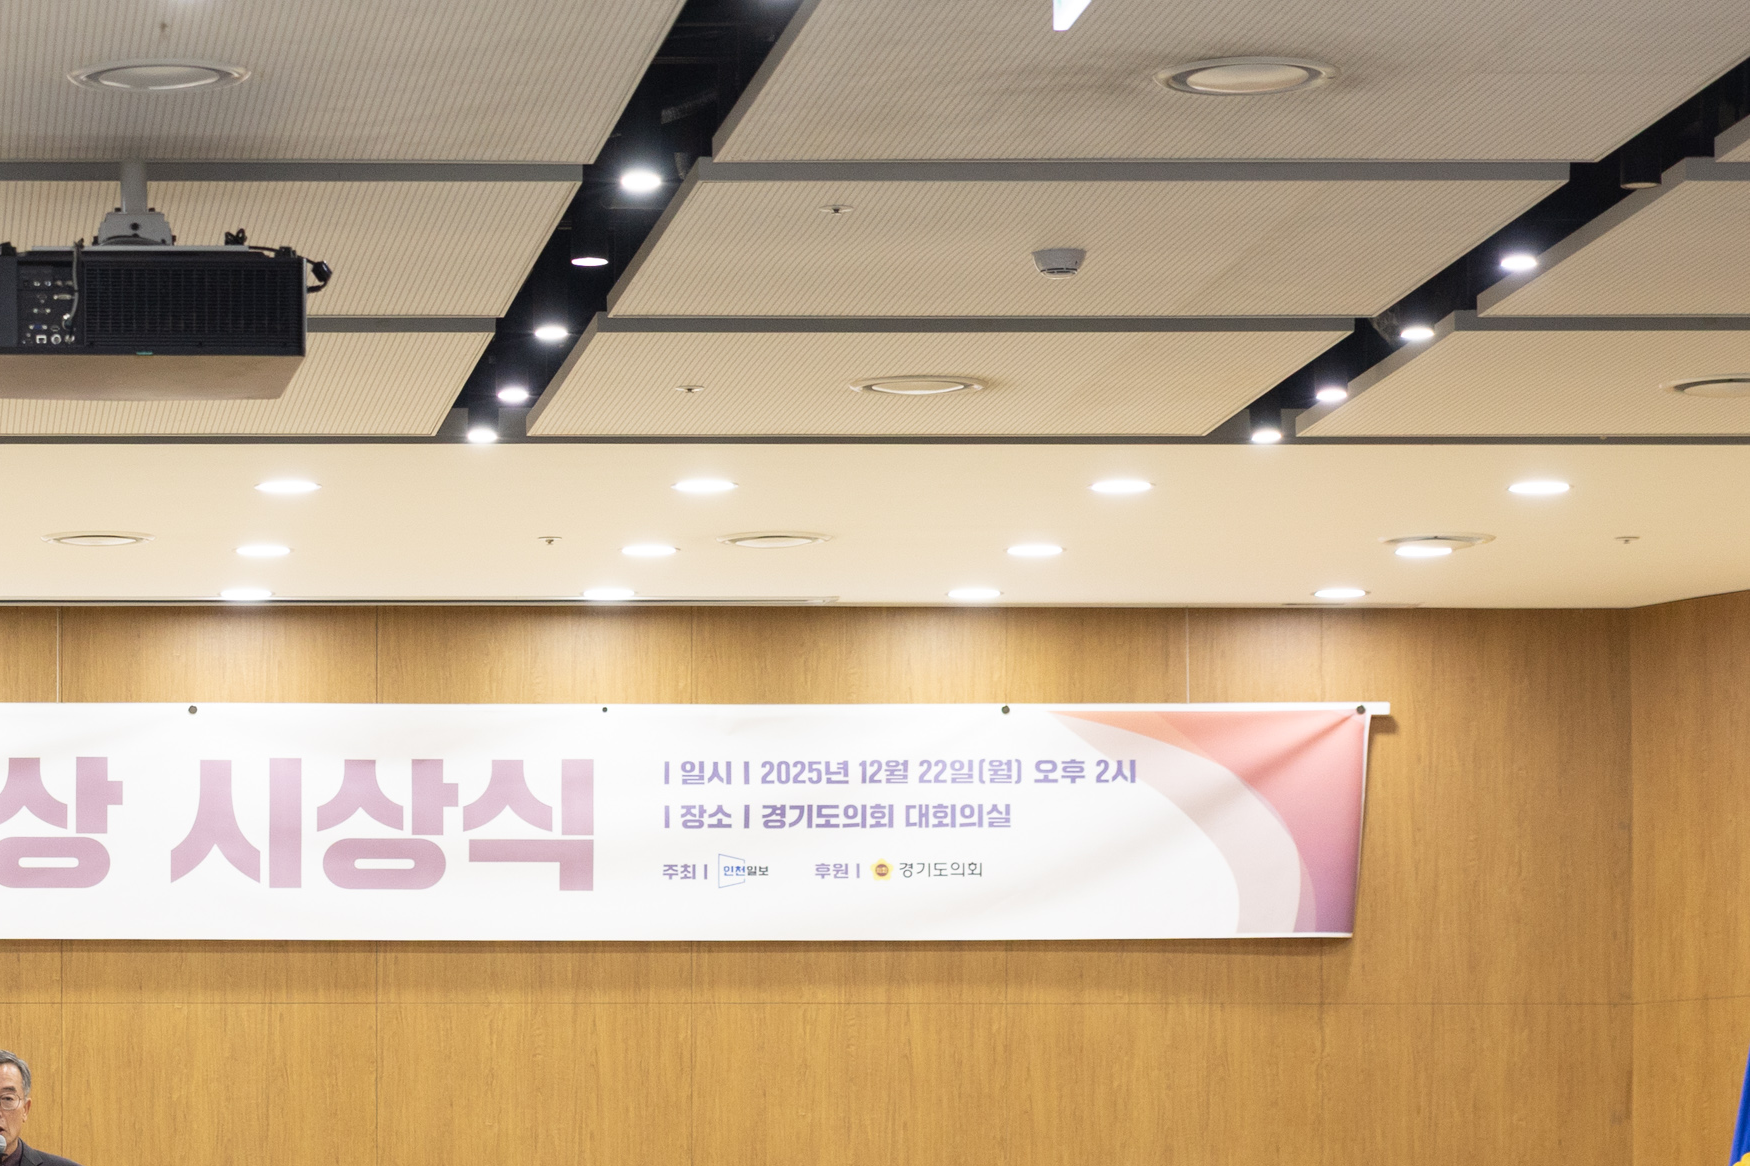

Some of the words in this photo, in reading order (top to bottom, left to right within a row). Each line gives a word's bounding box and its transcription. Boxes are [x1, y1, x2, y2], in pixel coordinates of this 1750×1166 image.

[680, 760, 733, 786] 일시
[760, 759, 850, 785] 2025년
[858, 759, 909, 785] 12월
[918, 758, 1023, 785] 22일(월)
[1033, 758, 1086, 785] 오후
[1095, 758, 1137, 784] 2시
[169, 757, 595, 892] 시상식
[680, 804, 733, 830] 장소
[761, 803, 895, 830] 경기도의회
[904, 803, 1012, 829] 대회의실
[662, 863, 697, 881] 주최
[722, 865, 769, 877] 인천일보
[814, 862, 850, 880] 후원
[898, 861, 983, 879] 경기도의회
